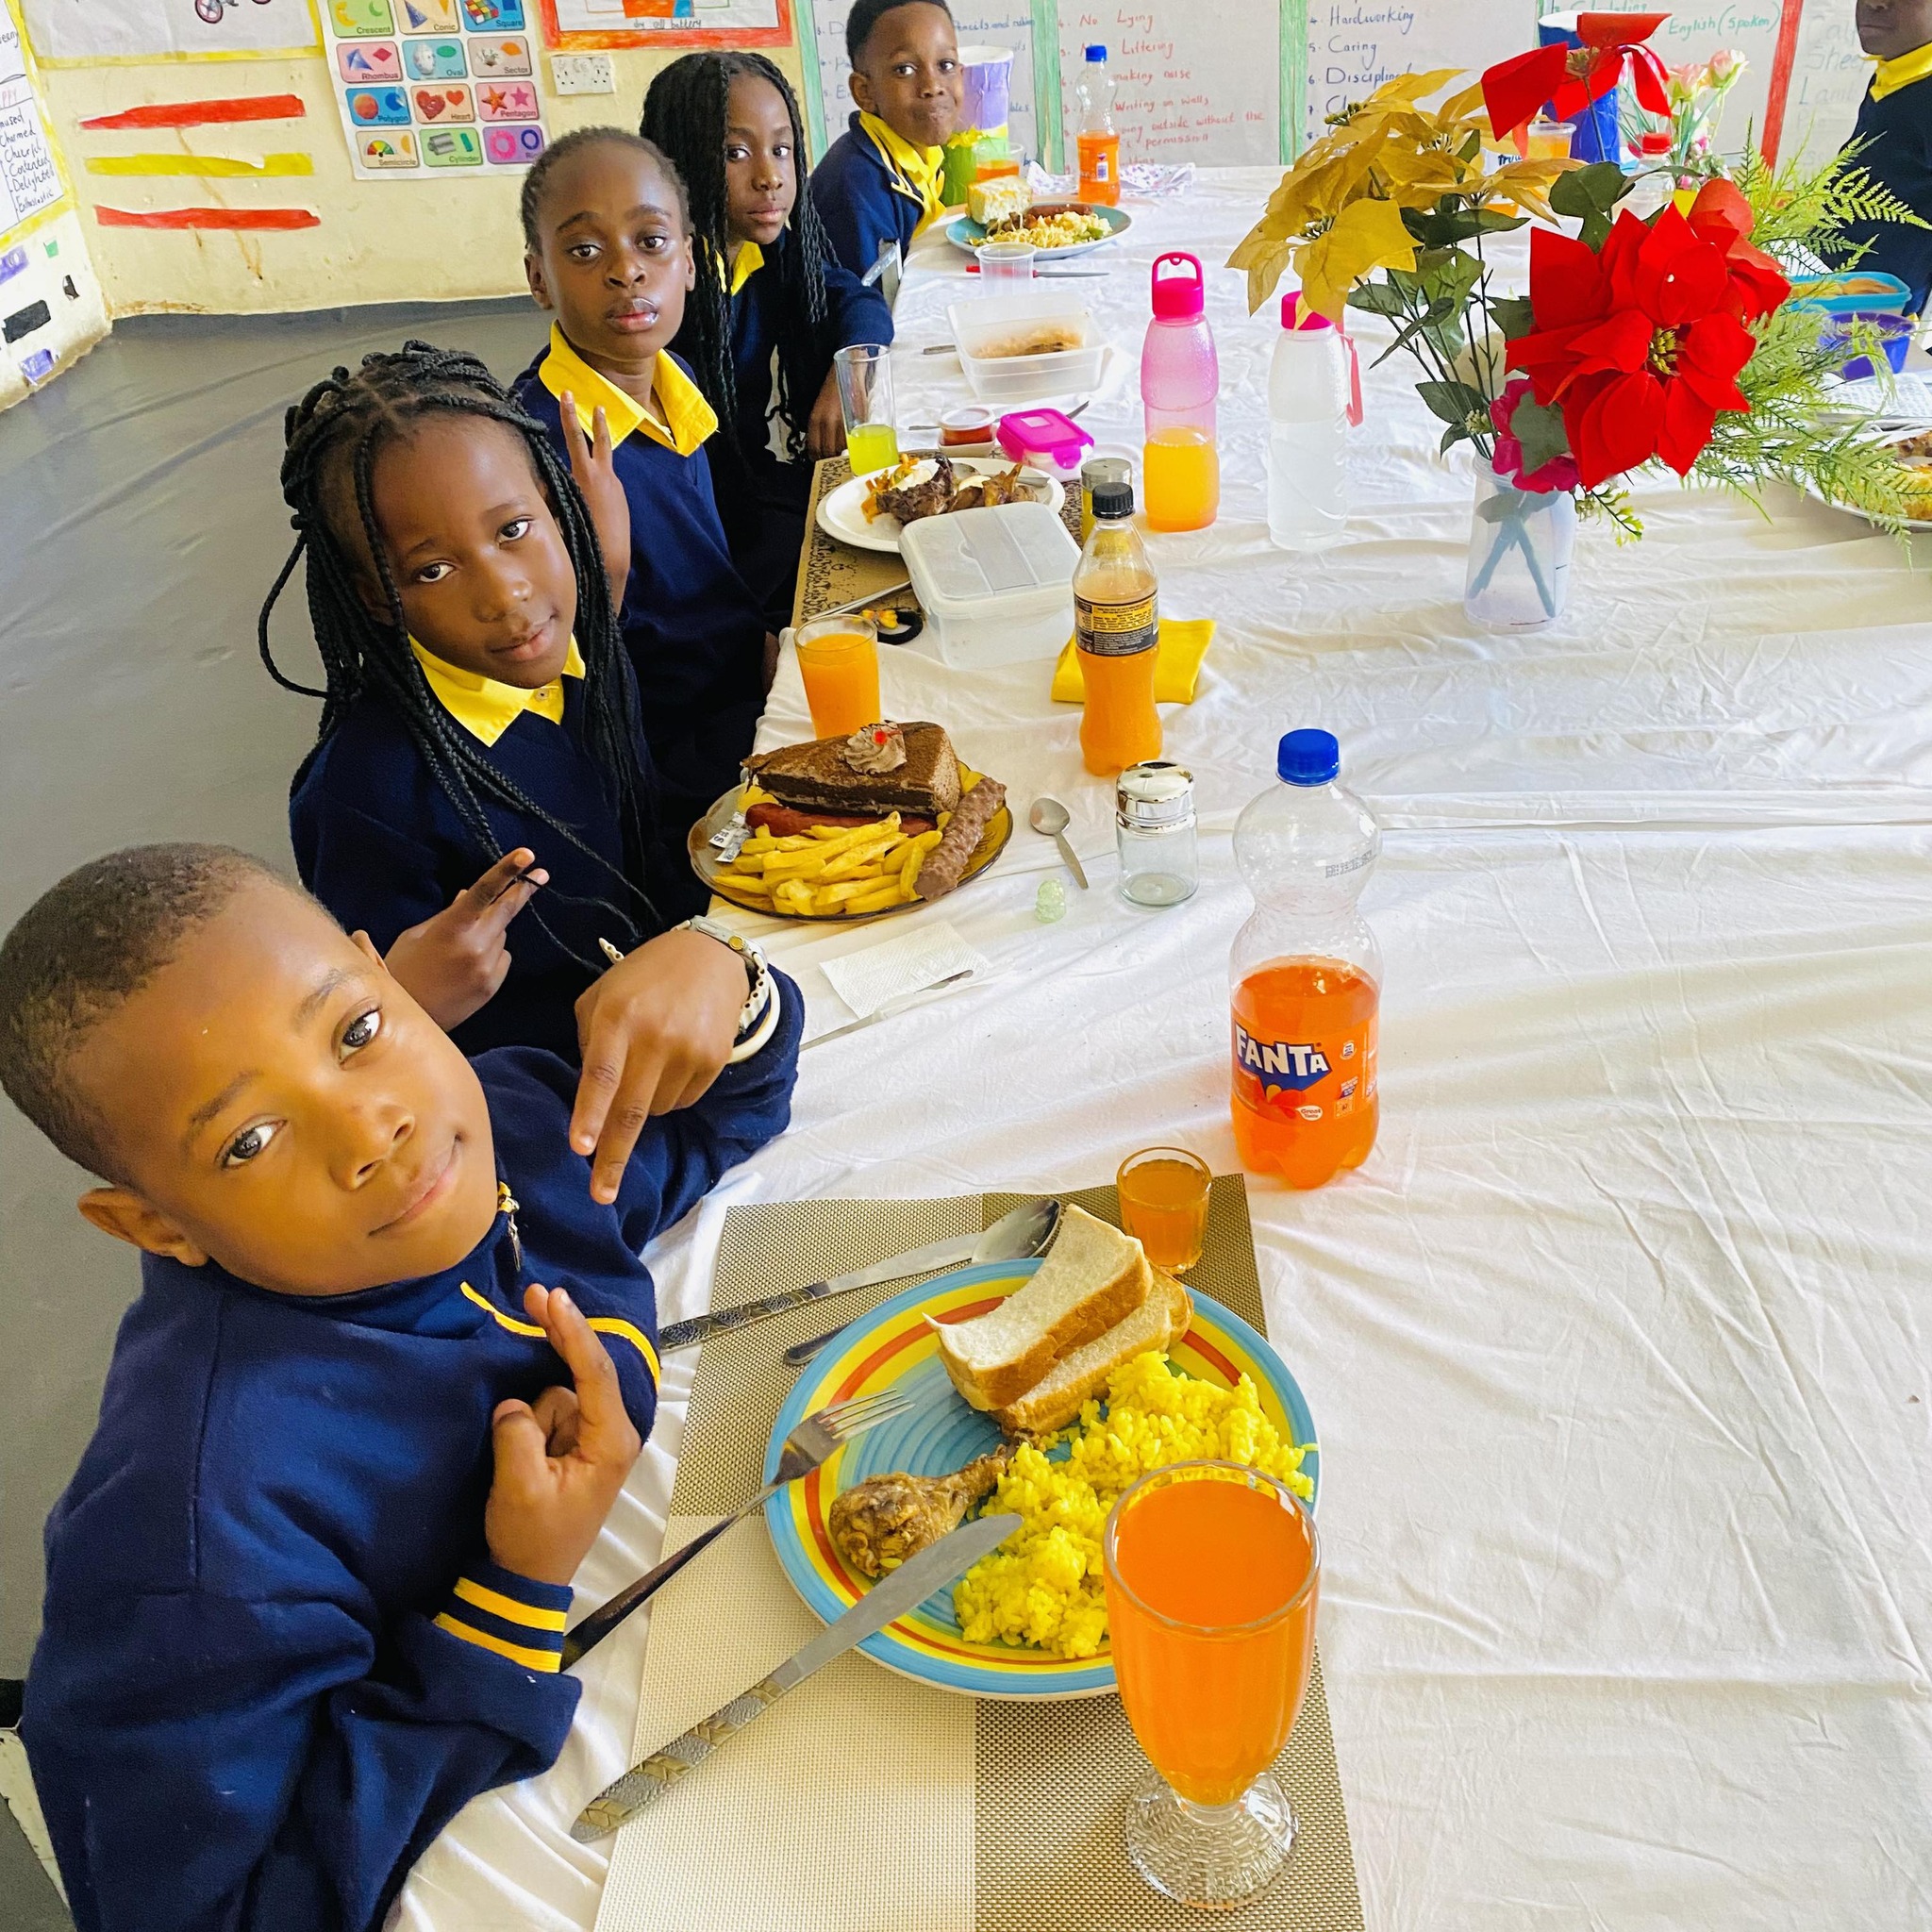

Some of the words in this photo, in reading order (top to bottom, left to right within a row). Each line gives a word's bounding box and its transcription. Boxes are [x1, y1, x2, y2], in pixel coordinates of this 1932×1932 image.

[495, 19, 523, 28] Square
[1079, 14, 1098, 27] No
[1117, 8, 1154, 34] Lying
[1330, 5, 1414, 35] Hardworking
[356, 25, 391, 35] Crescent
[1668, 16, 1716, 42] English
[1122, 38, 1174, 60] Littering
[1328, 35, 1377, 71] Caring
[446, 68, 464, 77] Oval
[504, 66, 528, 75] Sector
[361, 72, 399, 81] Rhombus
[377, 114, 408, 124] Polygon
[451, 112, 471, 121] Heart
[500, 109, 537, 119] Pentagon
[378, 158, 417, 167] Semicircle
[448, 155, 481, 164] Cylinder
[1235, 1024, 1328, 1076] FANTA
